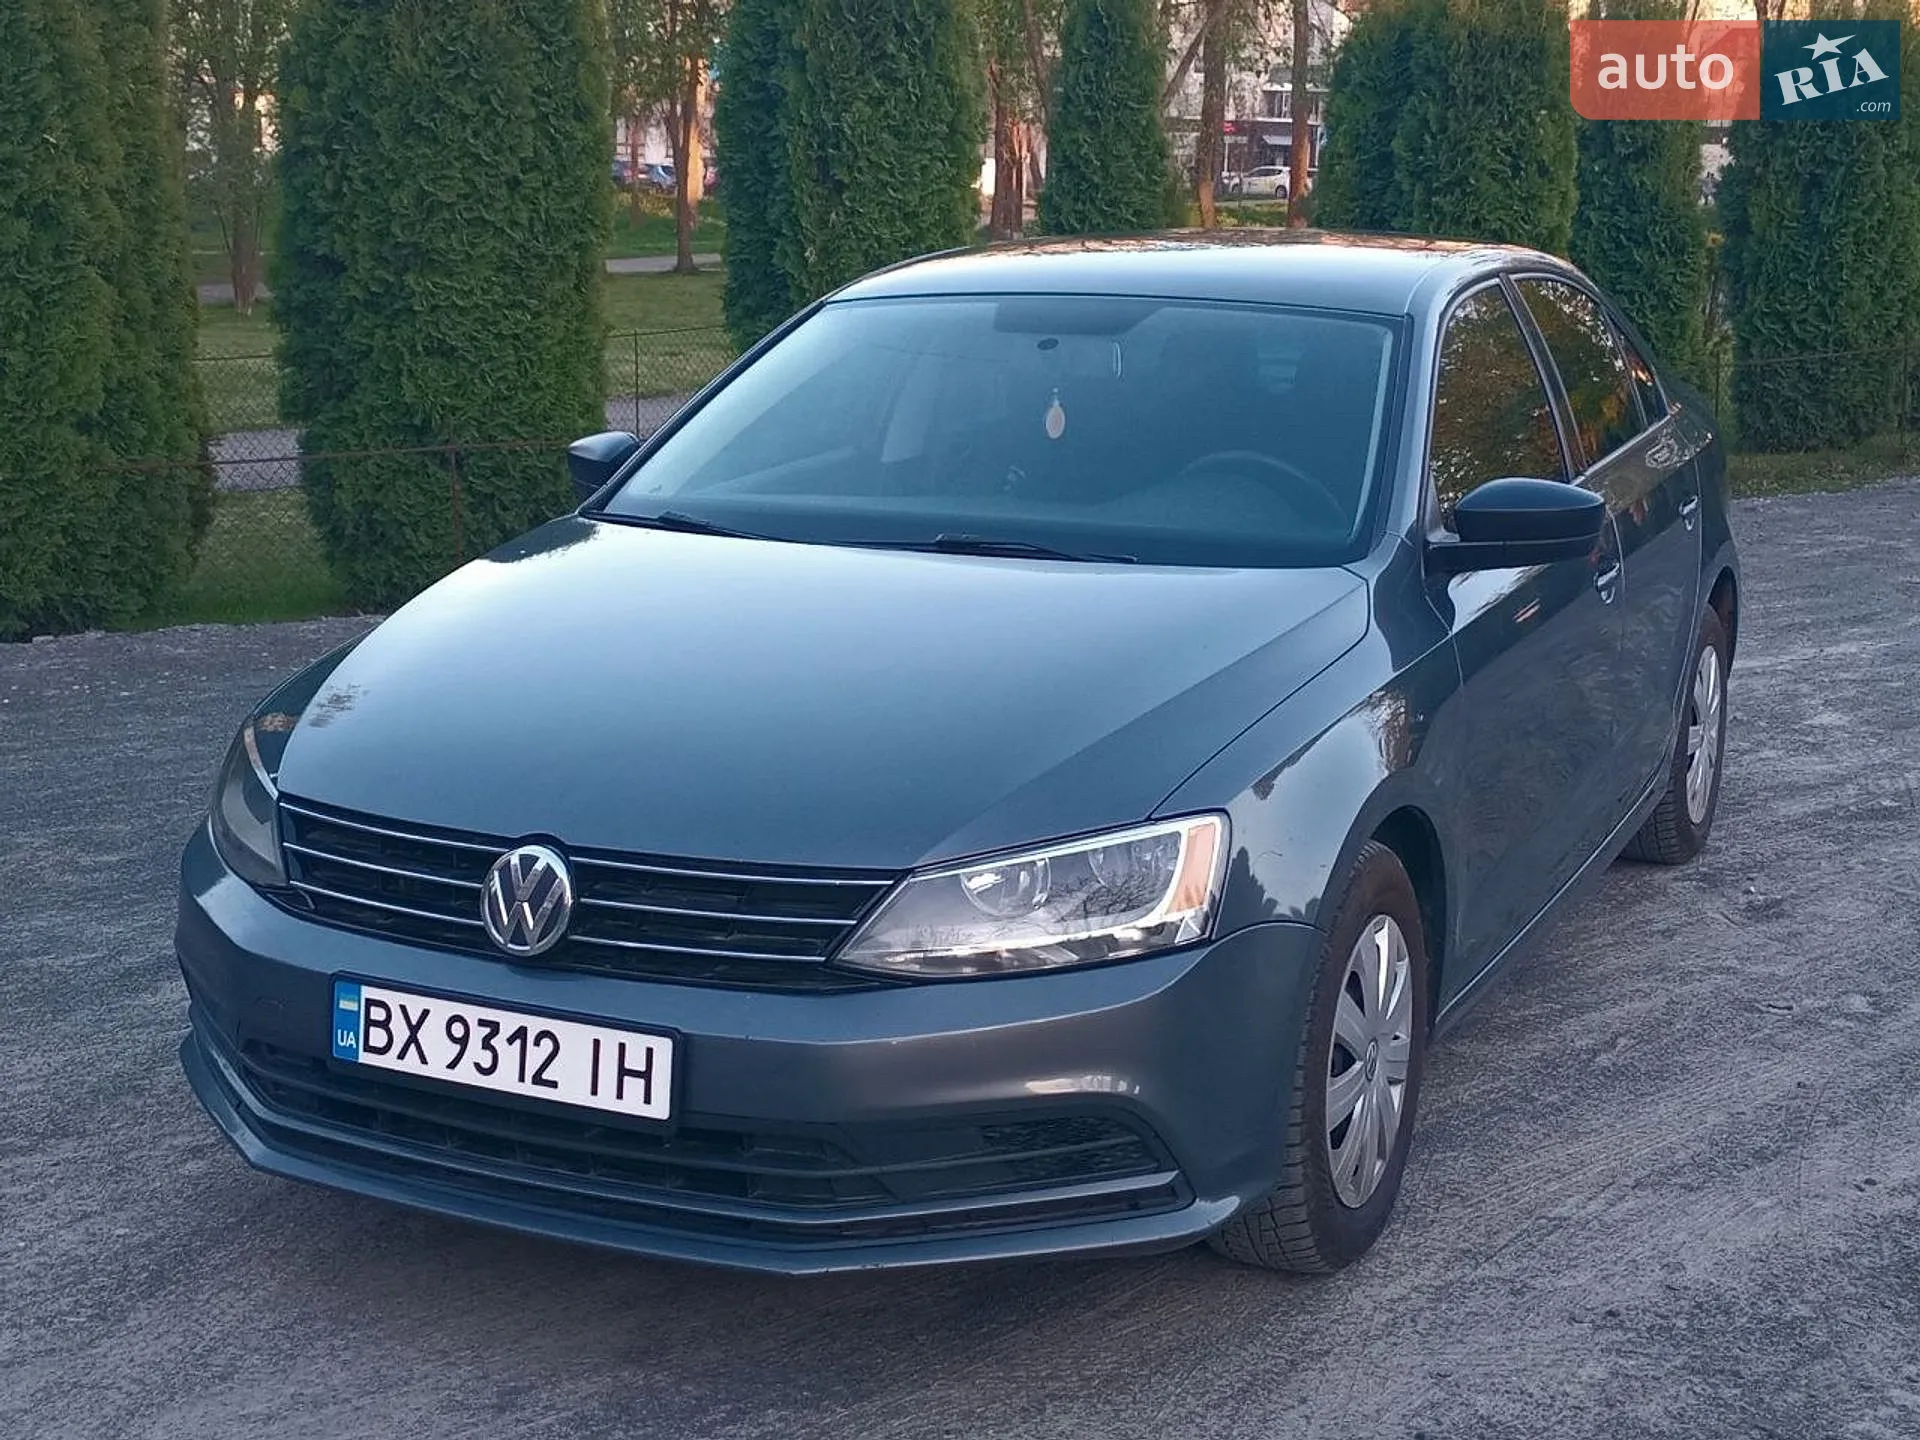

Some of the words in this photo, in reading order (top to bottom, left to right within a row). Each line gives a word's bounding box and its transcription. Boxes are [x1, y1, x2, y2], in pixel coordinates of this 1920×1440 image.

[484, 847, 570, 954] VW
[337, 1028, 357, 1049] UA
[362, 997, 431, 1066] BX
[444, 1014, 561, 1090] 9312
[589, 1037, 655, 1106] IH
